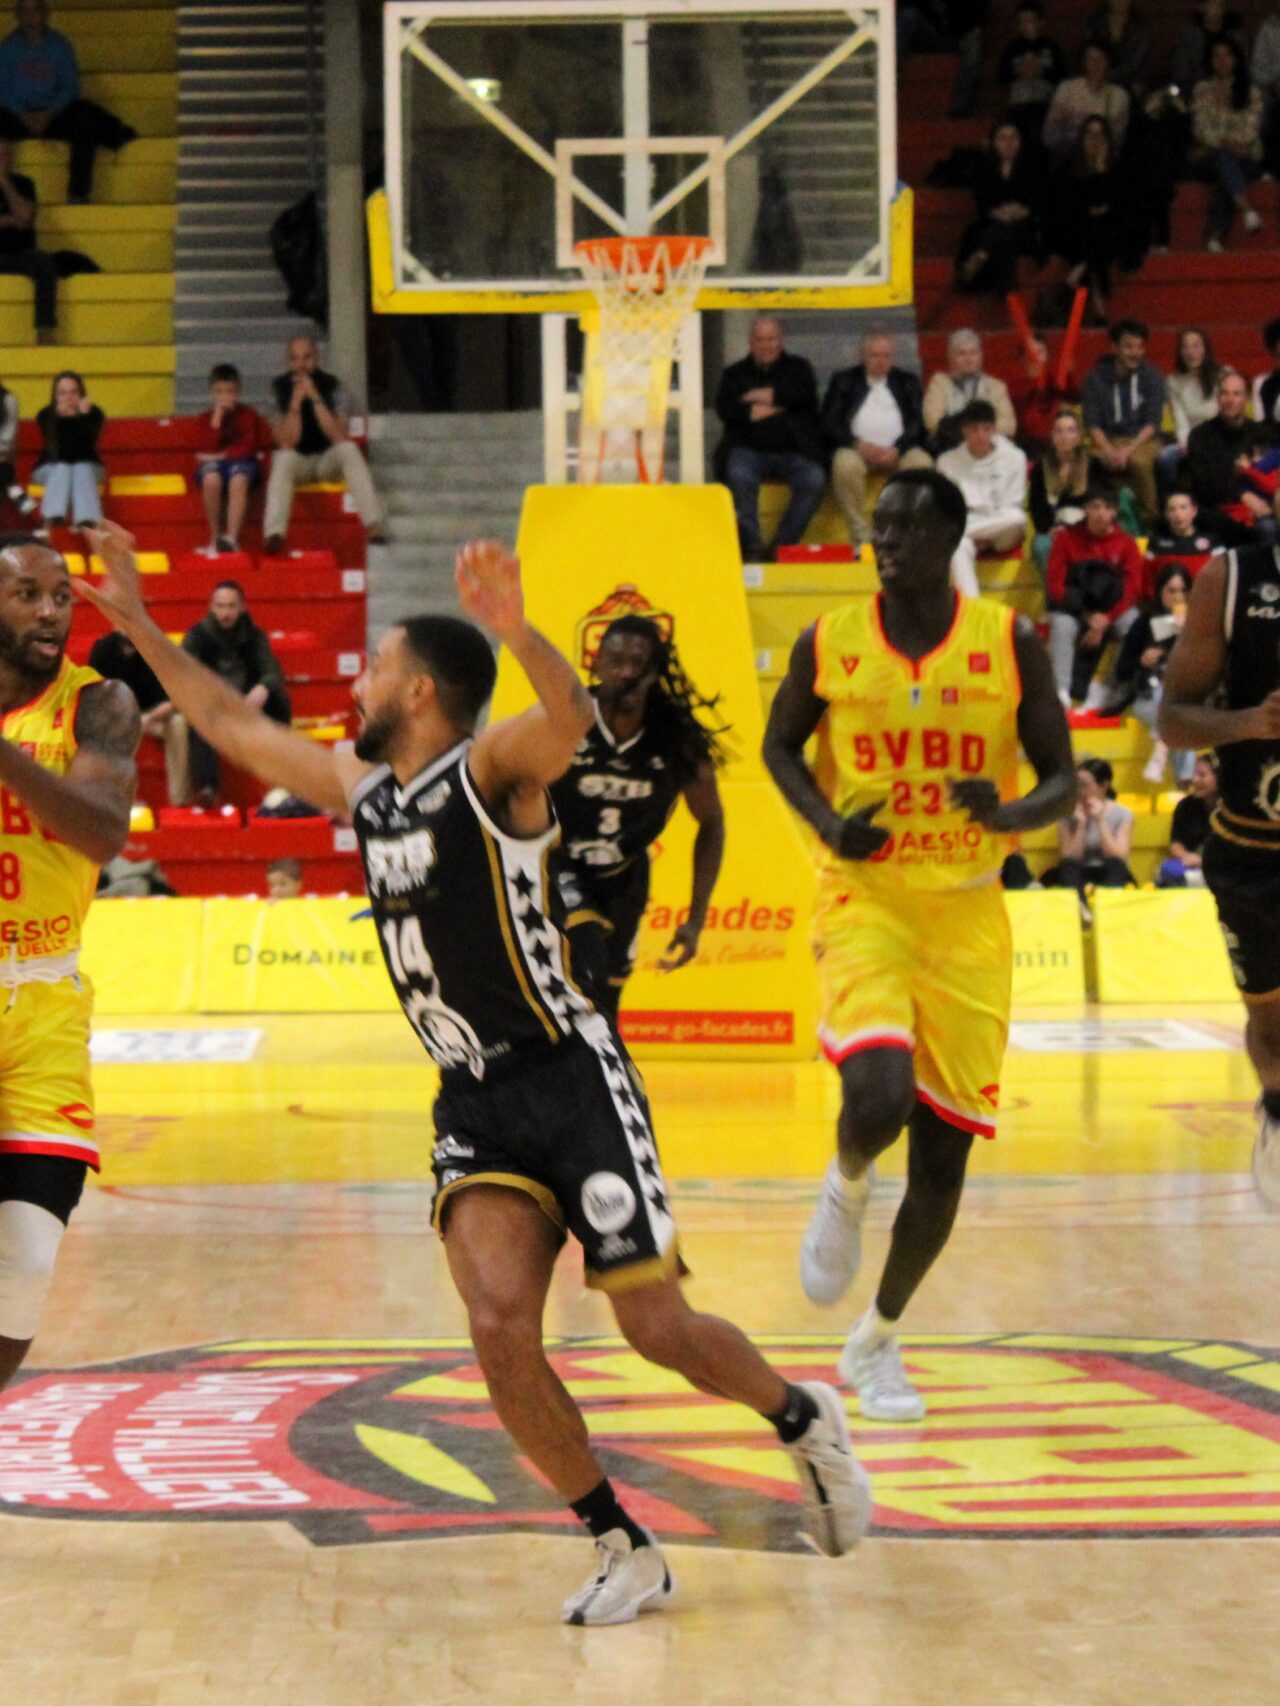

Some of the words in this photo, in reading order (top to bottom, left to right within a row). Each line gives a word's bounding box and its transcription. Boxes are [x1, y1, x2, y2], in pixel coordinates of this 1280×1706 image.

[854, 729, 986, 774] SVBD
[892, 781, 942, 816] 23
[598, 807, 621, 835] 3
[899, 825, 982, 851] AESIO
